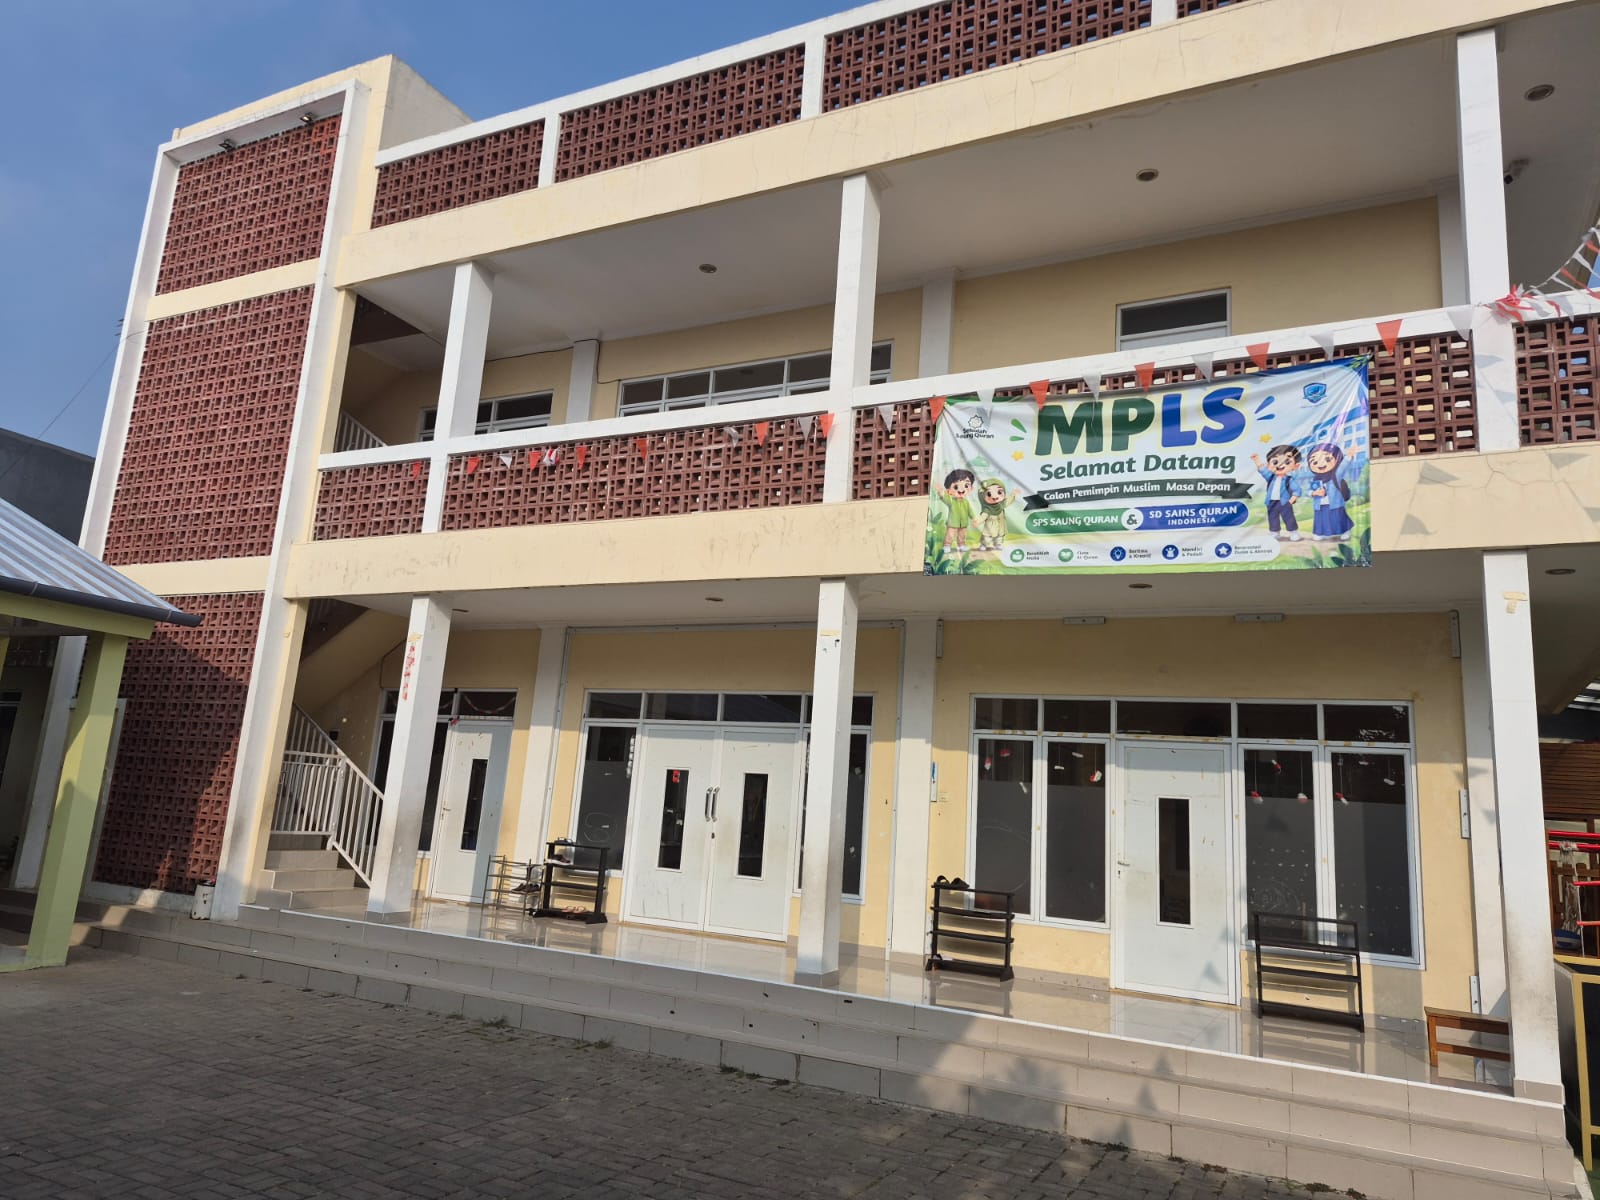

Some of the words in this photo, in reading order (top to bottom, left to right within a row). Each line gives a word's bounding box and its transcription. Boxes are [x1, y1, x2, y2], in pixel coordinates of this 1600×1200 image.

[1035, 386, 1246, 456] MPLS
[1040, 456, 1137, 481] Selamat
[1143, 454, 1236, 474] Datang
[1043, 491, 1071, 500] Calon
[1072, 485, 1120, 497] Pemimpin
[1123, 482, 1160, 494] Muslim
[1166, 482, 1194, 492] Masa
[1197, 482, 1231, 493] Depan
[1149, 510, 1162, 518] SD
[1165, 508, 1196, 518] SAINS
[1199, 506, 1237, 517] QURAN
[1032, 518, 1048, 527] SPS
[1049, 516, 1081, 526] SAUNG
[1083, 515, 1119, 526] QURAN
[1126, 514, 1138, 525] &
[1168, 517, 1216, 526] INDONESIA
